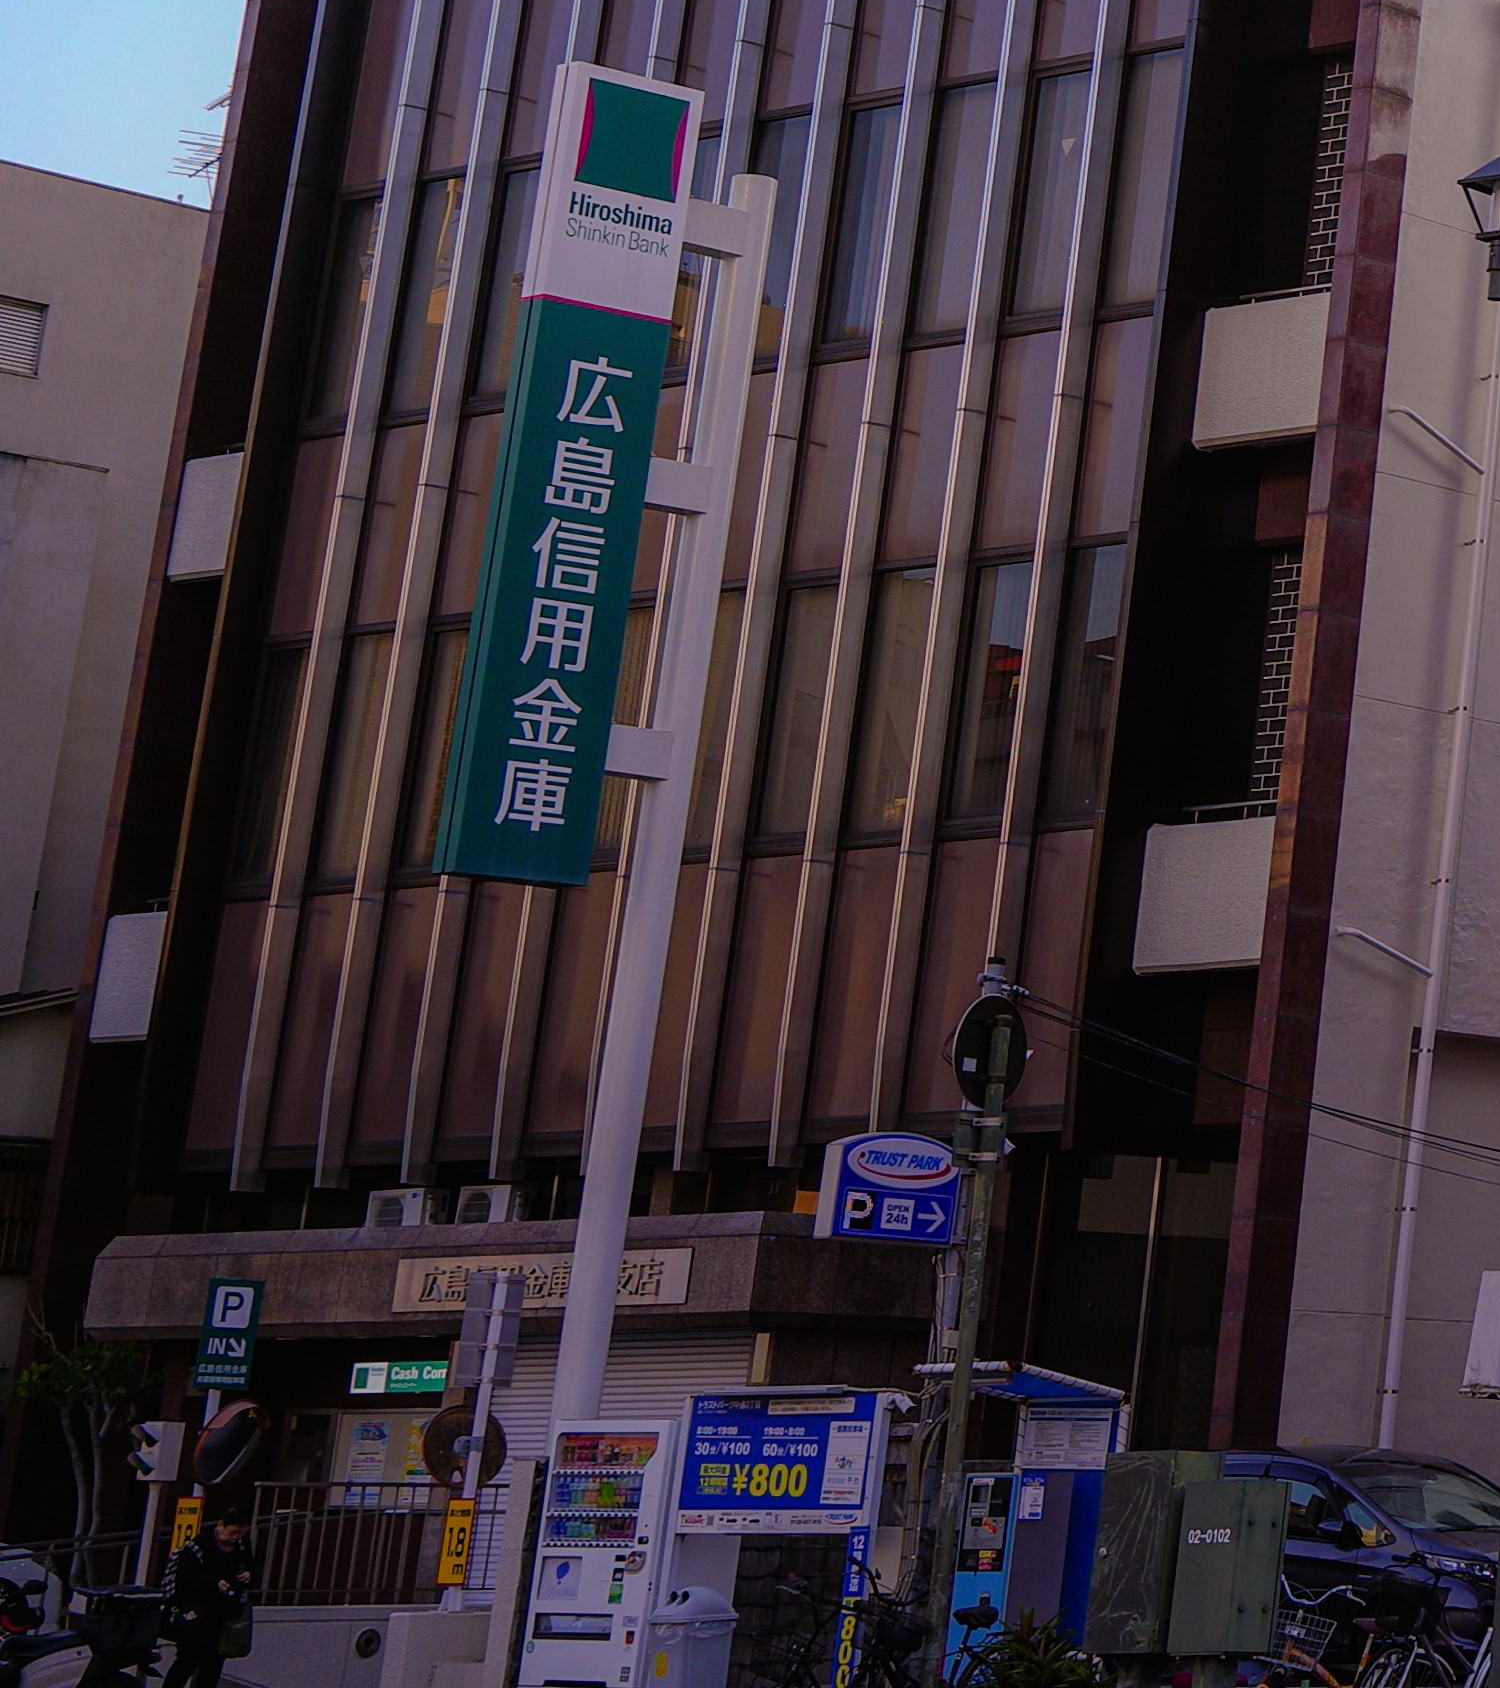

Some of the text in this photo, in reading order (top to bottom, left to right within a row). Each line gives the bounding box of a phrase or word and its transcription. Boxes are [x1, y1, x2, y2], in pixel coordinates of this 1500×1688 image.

[569, 190, 674, 237] Hiroshima
[565, 216, 670, 259] Shinkin Bank
[493, 354, 635, 833] 広島信用金庫
[865, 1150, 944, 1171] TRUST PARK
[843, 1192, 874, 1229] P
[885, 1213, 908, 1225] 24h
[887, 1204, 911, 1213] OPEN
[220, 1291, 244, 1323] P
[207, 1337, 227, 1355] IN
[390, 1365, 419, 1381] Cash
[732, 1463, 808, 1498] ¥800
[852, 1534, 865, 1550] 12
[1188, 1528, 1231, 1544] 02-0102
